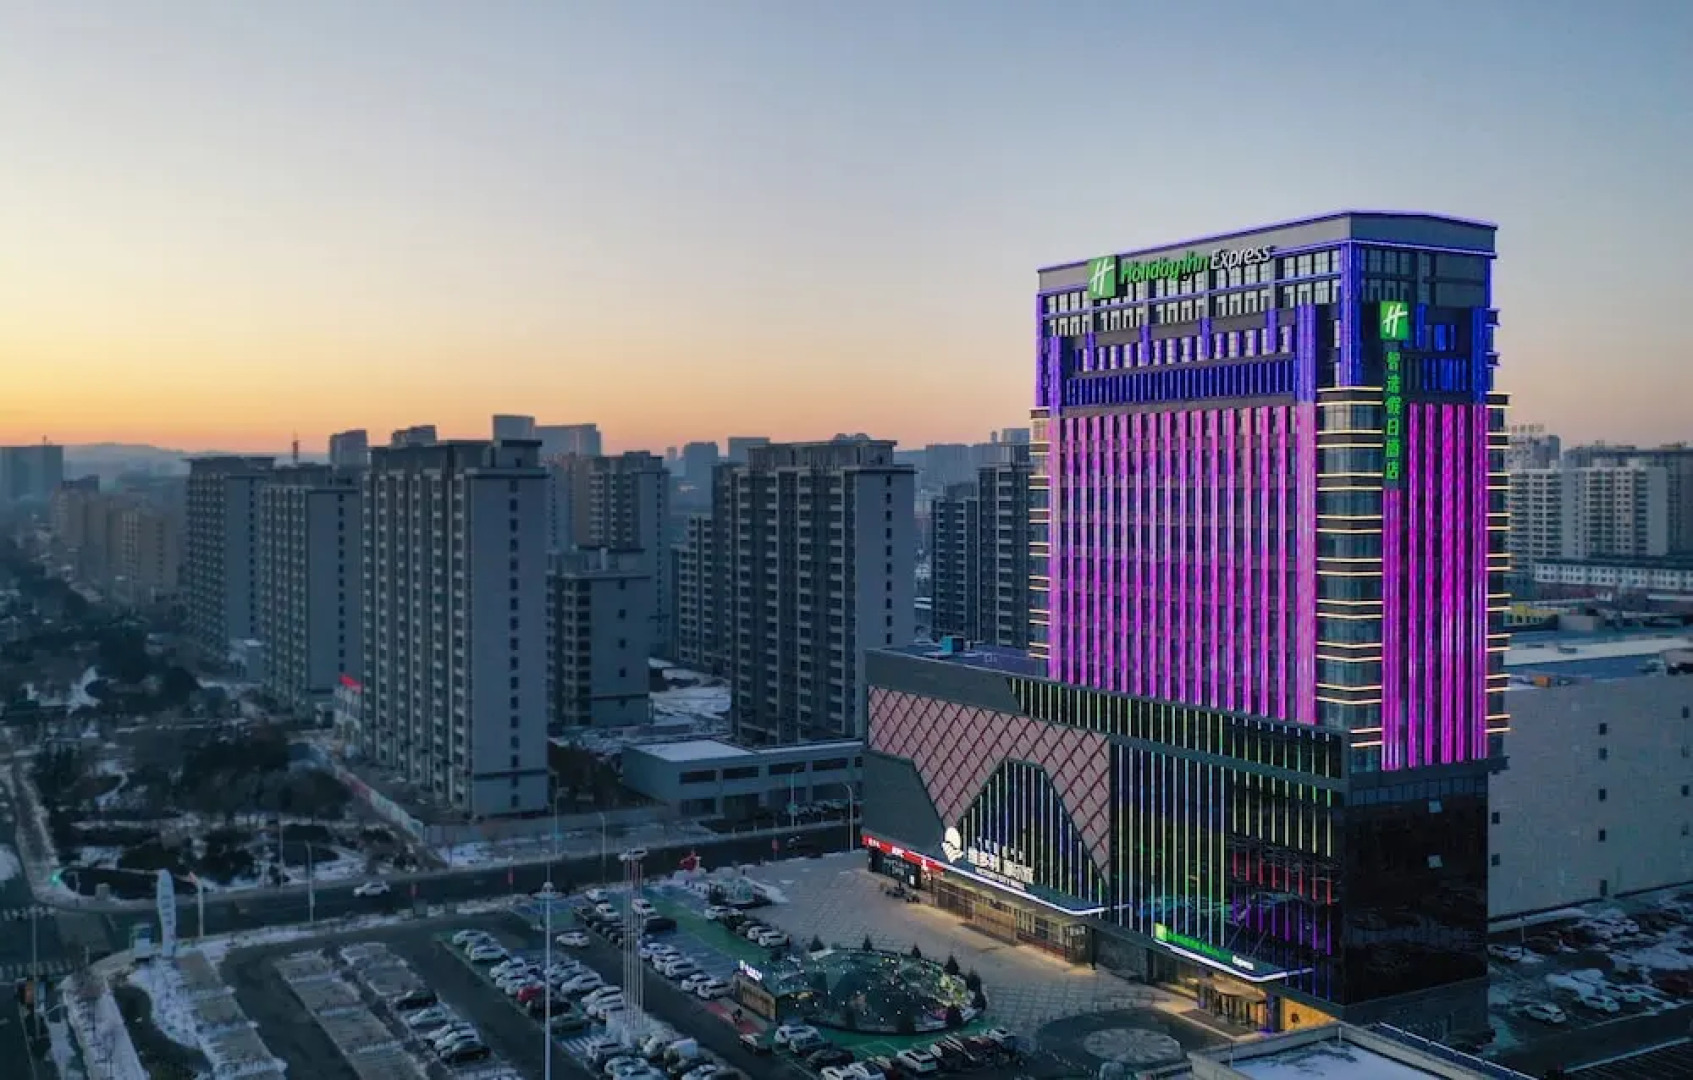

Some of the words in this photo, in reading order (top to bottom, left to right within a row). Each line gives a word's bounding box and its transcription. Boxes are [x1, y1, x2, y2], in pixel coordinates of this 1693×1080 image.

[1121, 257, 1180, 284] Holiday
[1181, 252, 1209, 275] Inn
[1210, 245, 1271, 271] Express
